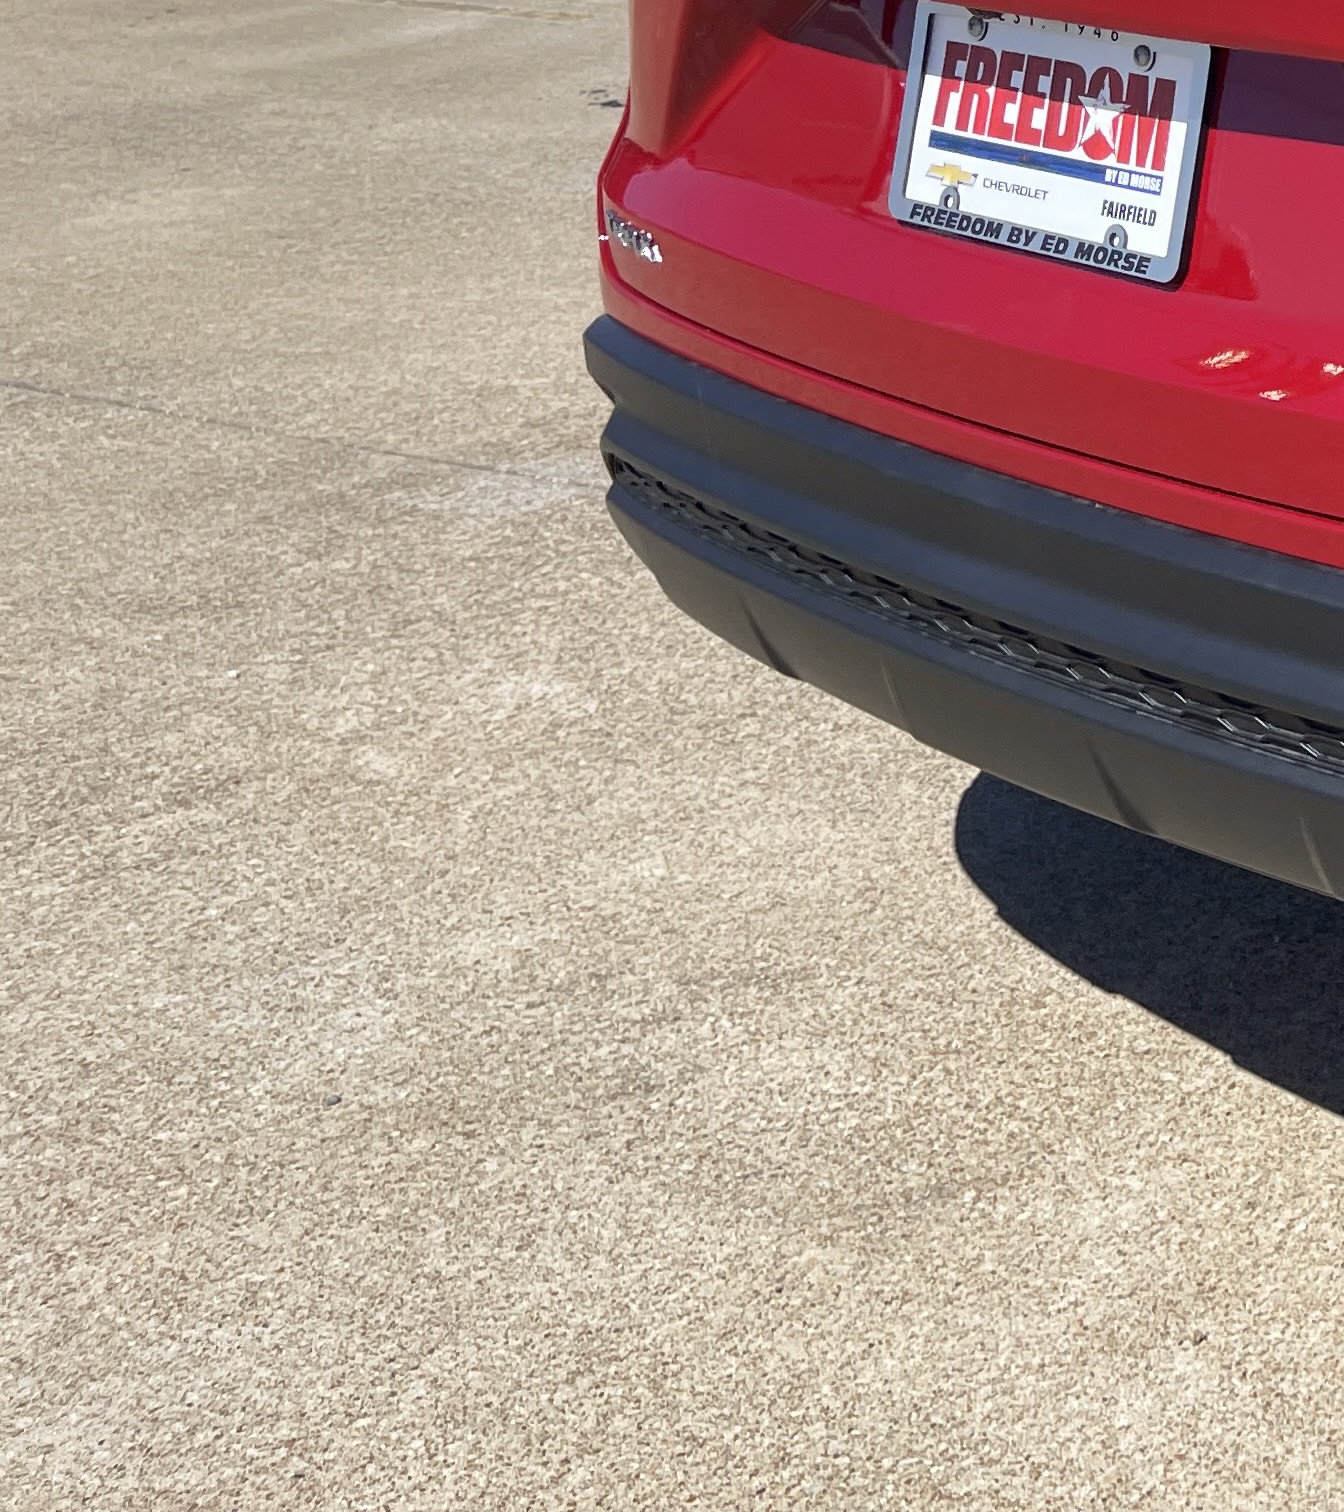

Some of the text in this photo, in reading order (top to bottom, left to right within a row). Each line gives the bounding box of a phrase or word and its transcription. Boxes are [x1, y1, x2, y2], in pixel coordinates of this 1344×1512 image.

[932, 41, 1177, 171] FREEDOM
[983, 178, 1049, 201] CHEVROLET
[1105, 170, 1162, 193] BY ED MORSE
[1101, 199, 1157, 227] FAIRFIELD
[909, 203, 1152, 275] FREEDOM BY ED MORSE
